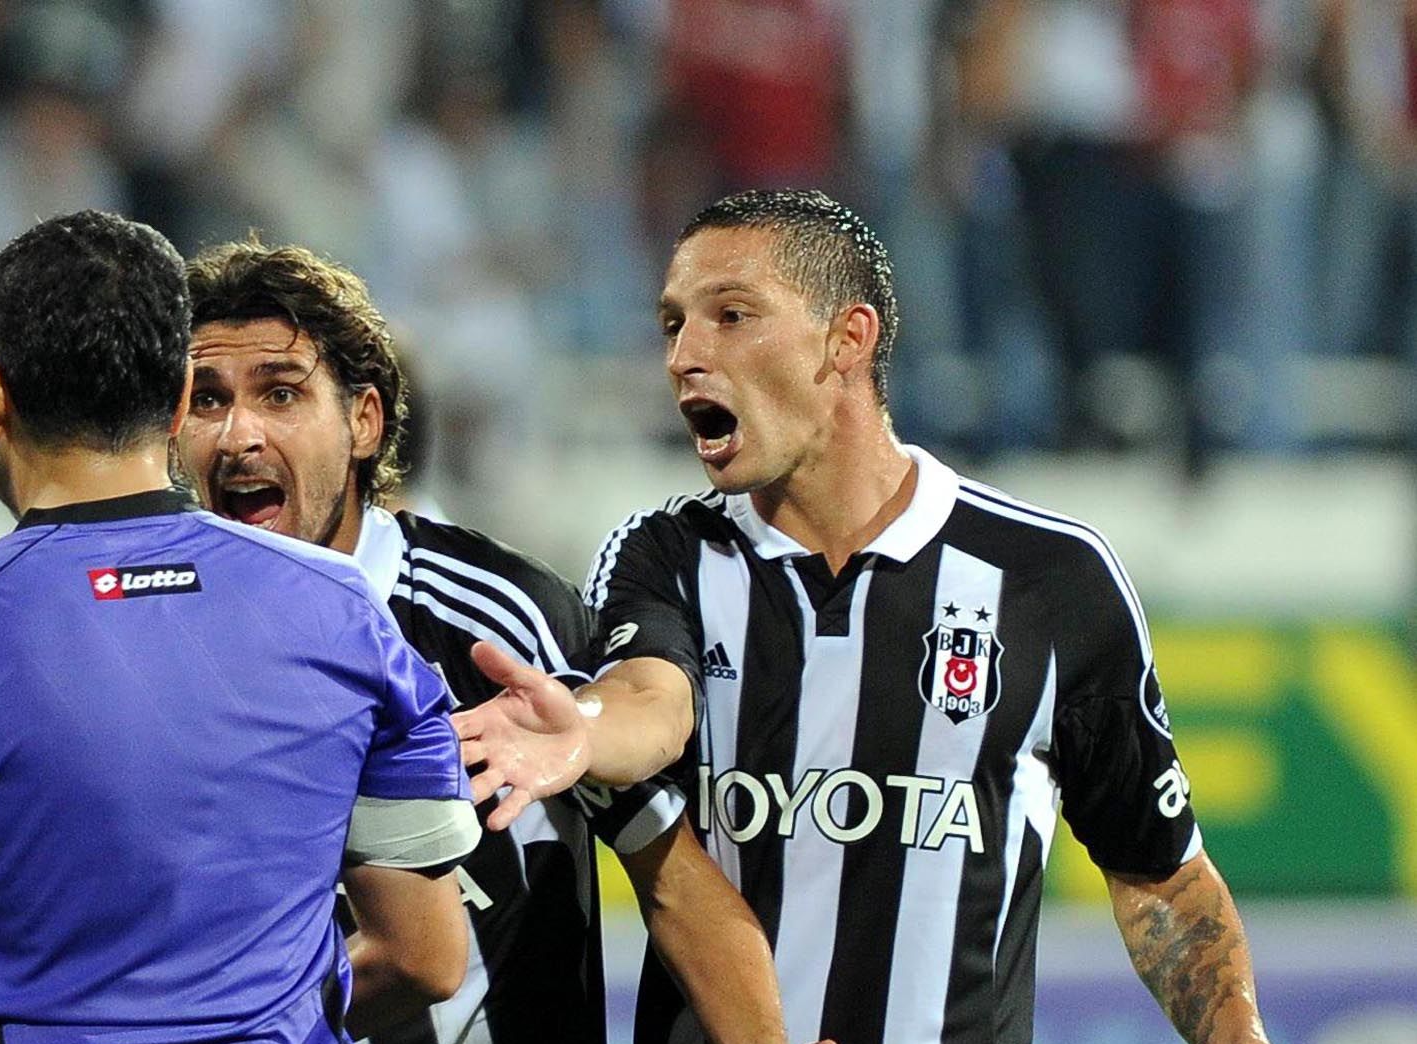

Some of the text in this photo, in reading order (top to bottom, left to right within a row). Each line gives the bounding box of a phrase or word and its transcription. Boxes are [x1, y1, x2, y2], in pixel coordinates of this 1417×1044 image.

[938, 632, 989, 657] BJK
[702, 662, 738, 681] didas
[937, 695, 982, 714] 1903
